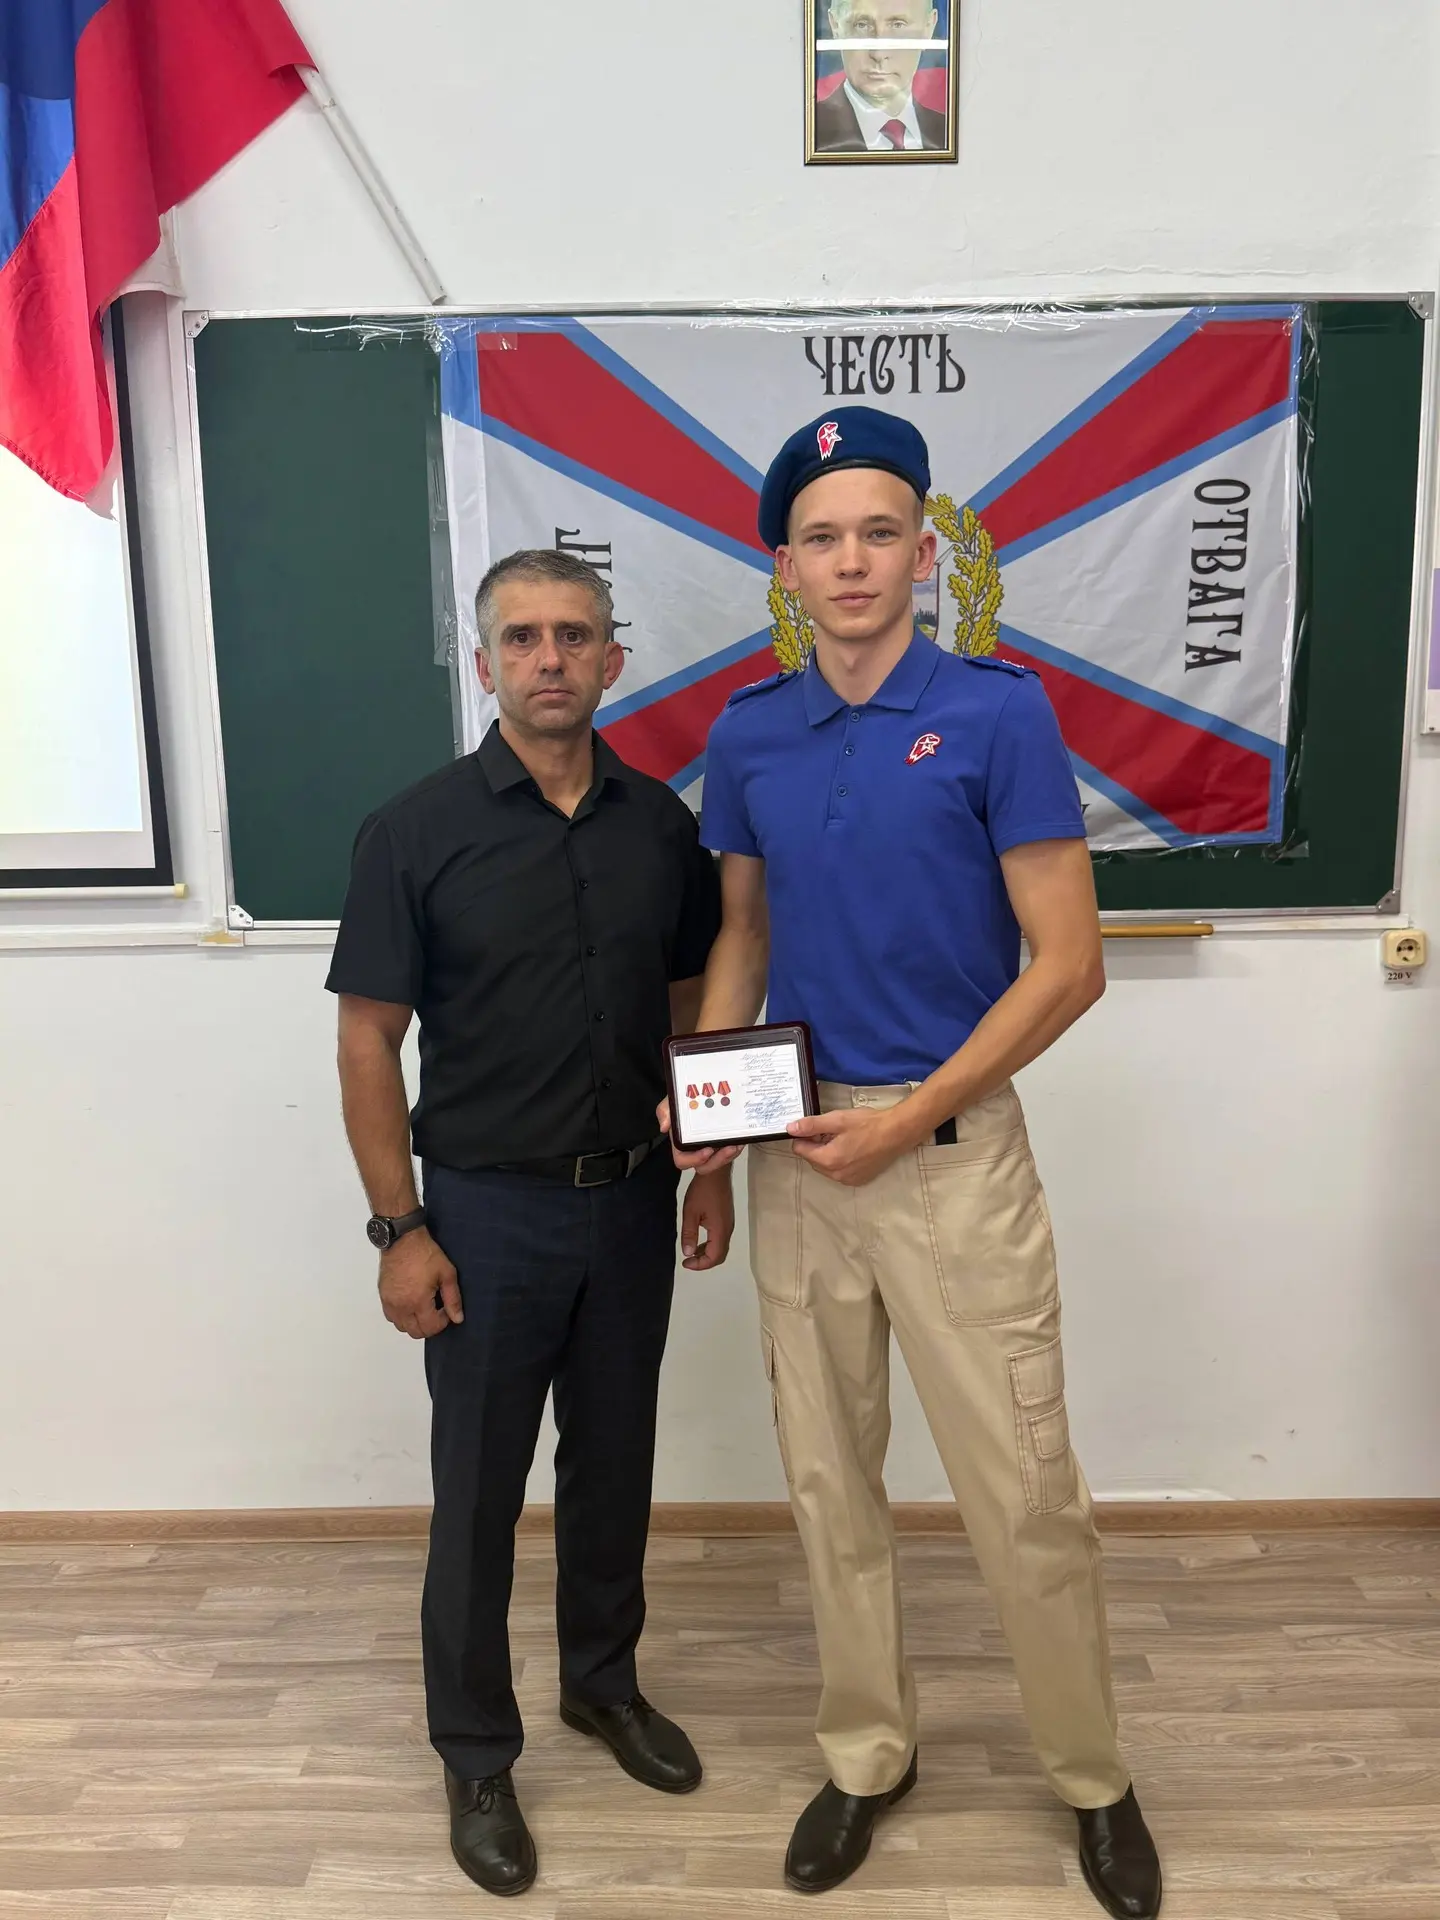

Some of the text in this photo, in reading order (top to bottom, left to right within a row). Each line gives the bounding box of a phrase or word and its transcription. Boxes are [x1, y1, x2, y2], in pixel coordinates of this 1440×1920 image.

[802, 333, 965, 395] ЧЕСТЬ
[1184, 478, 1250, 674] ОТВАГА
[1387, 972, 1403, 980] 220
